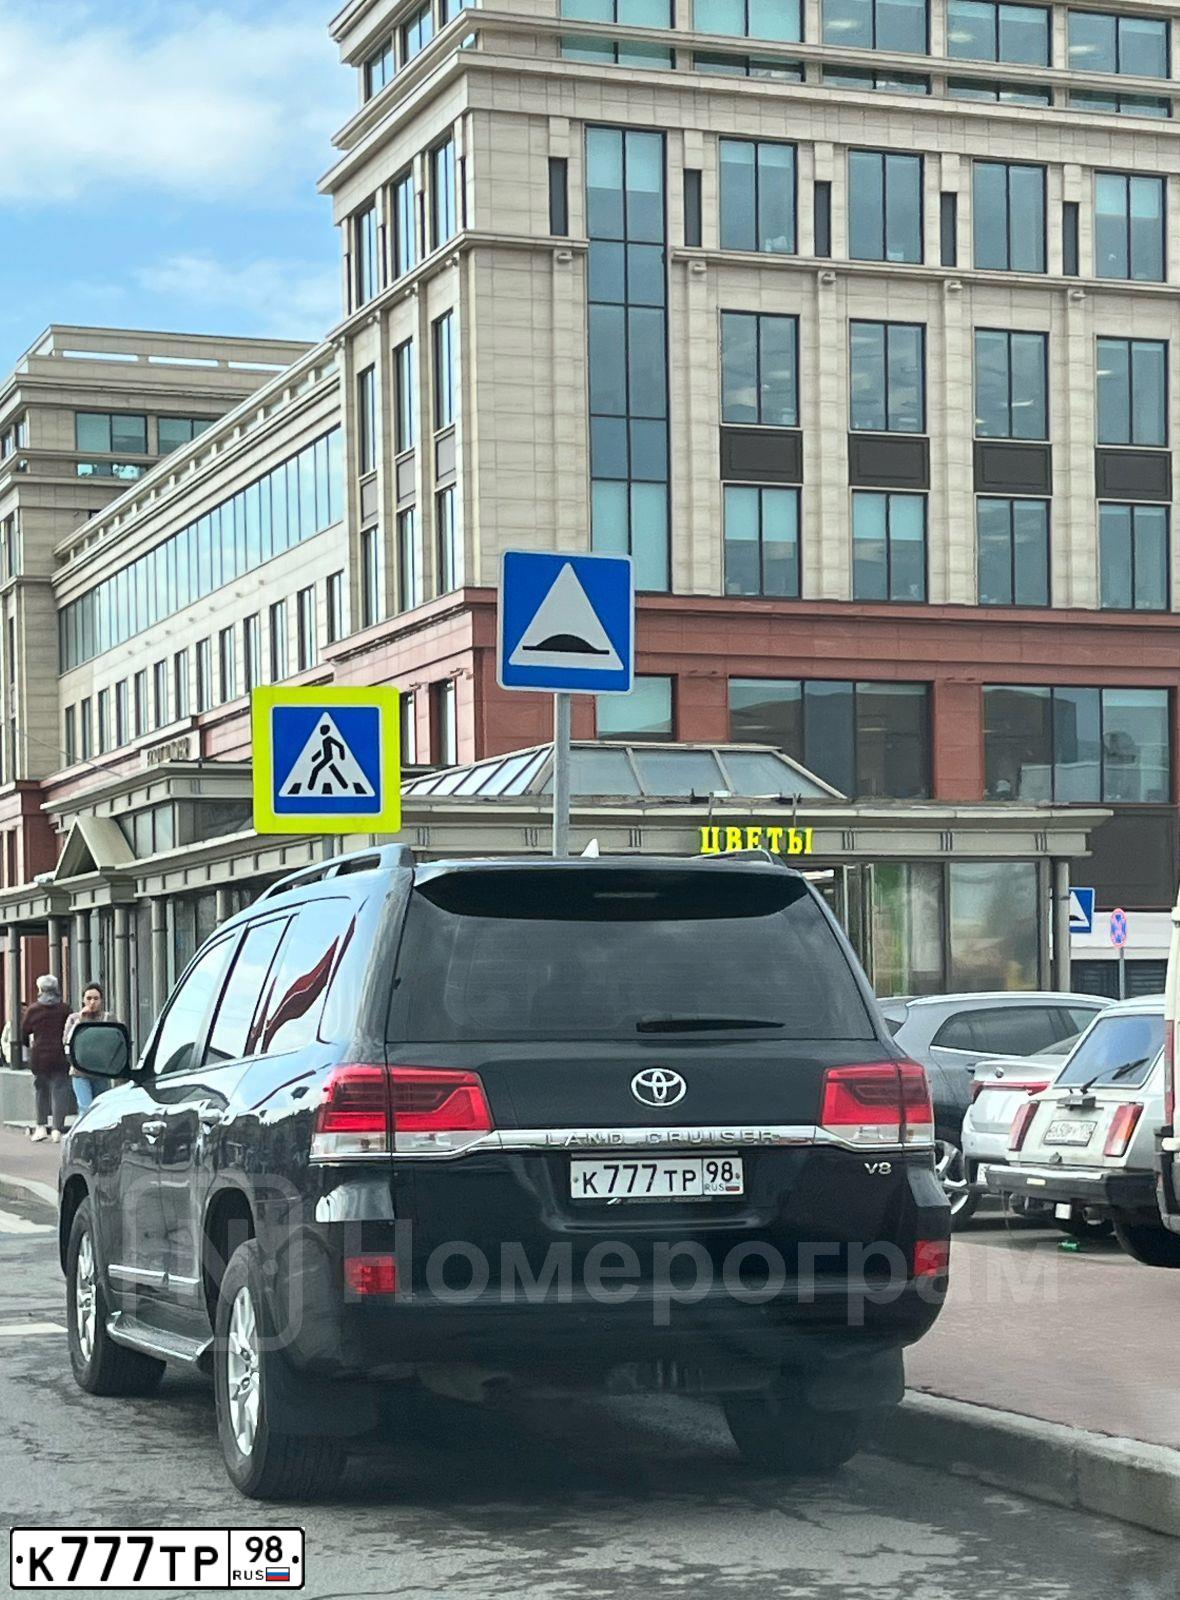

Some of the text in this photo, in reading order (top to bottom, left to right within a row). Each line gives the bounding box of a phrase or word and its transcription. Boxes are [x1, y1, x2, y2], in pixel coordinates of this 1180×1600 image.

[700, 826, 813, 855] ЦВЕТЫ
[546, 1130, 779, 1147] LAND CRUISER
[863, 1161, 892, 1175] V8
[582, 1160, 733, 1195] К777ТР 98
[704, 1183, 725, 1192] RUS
